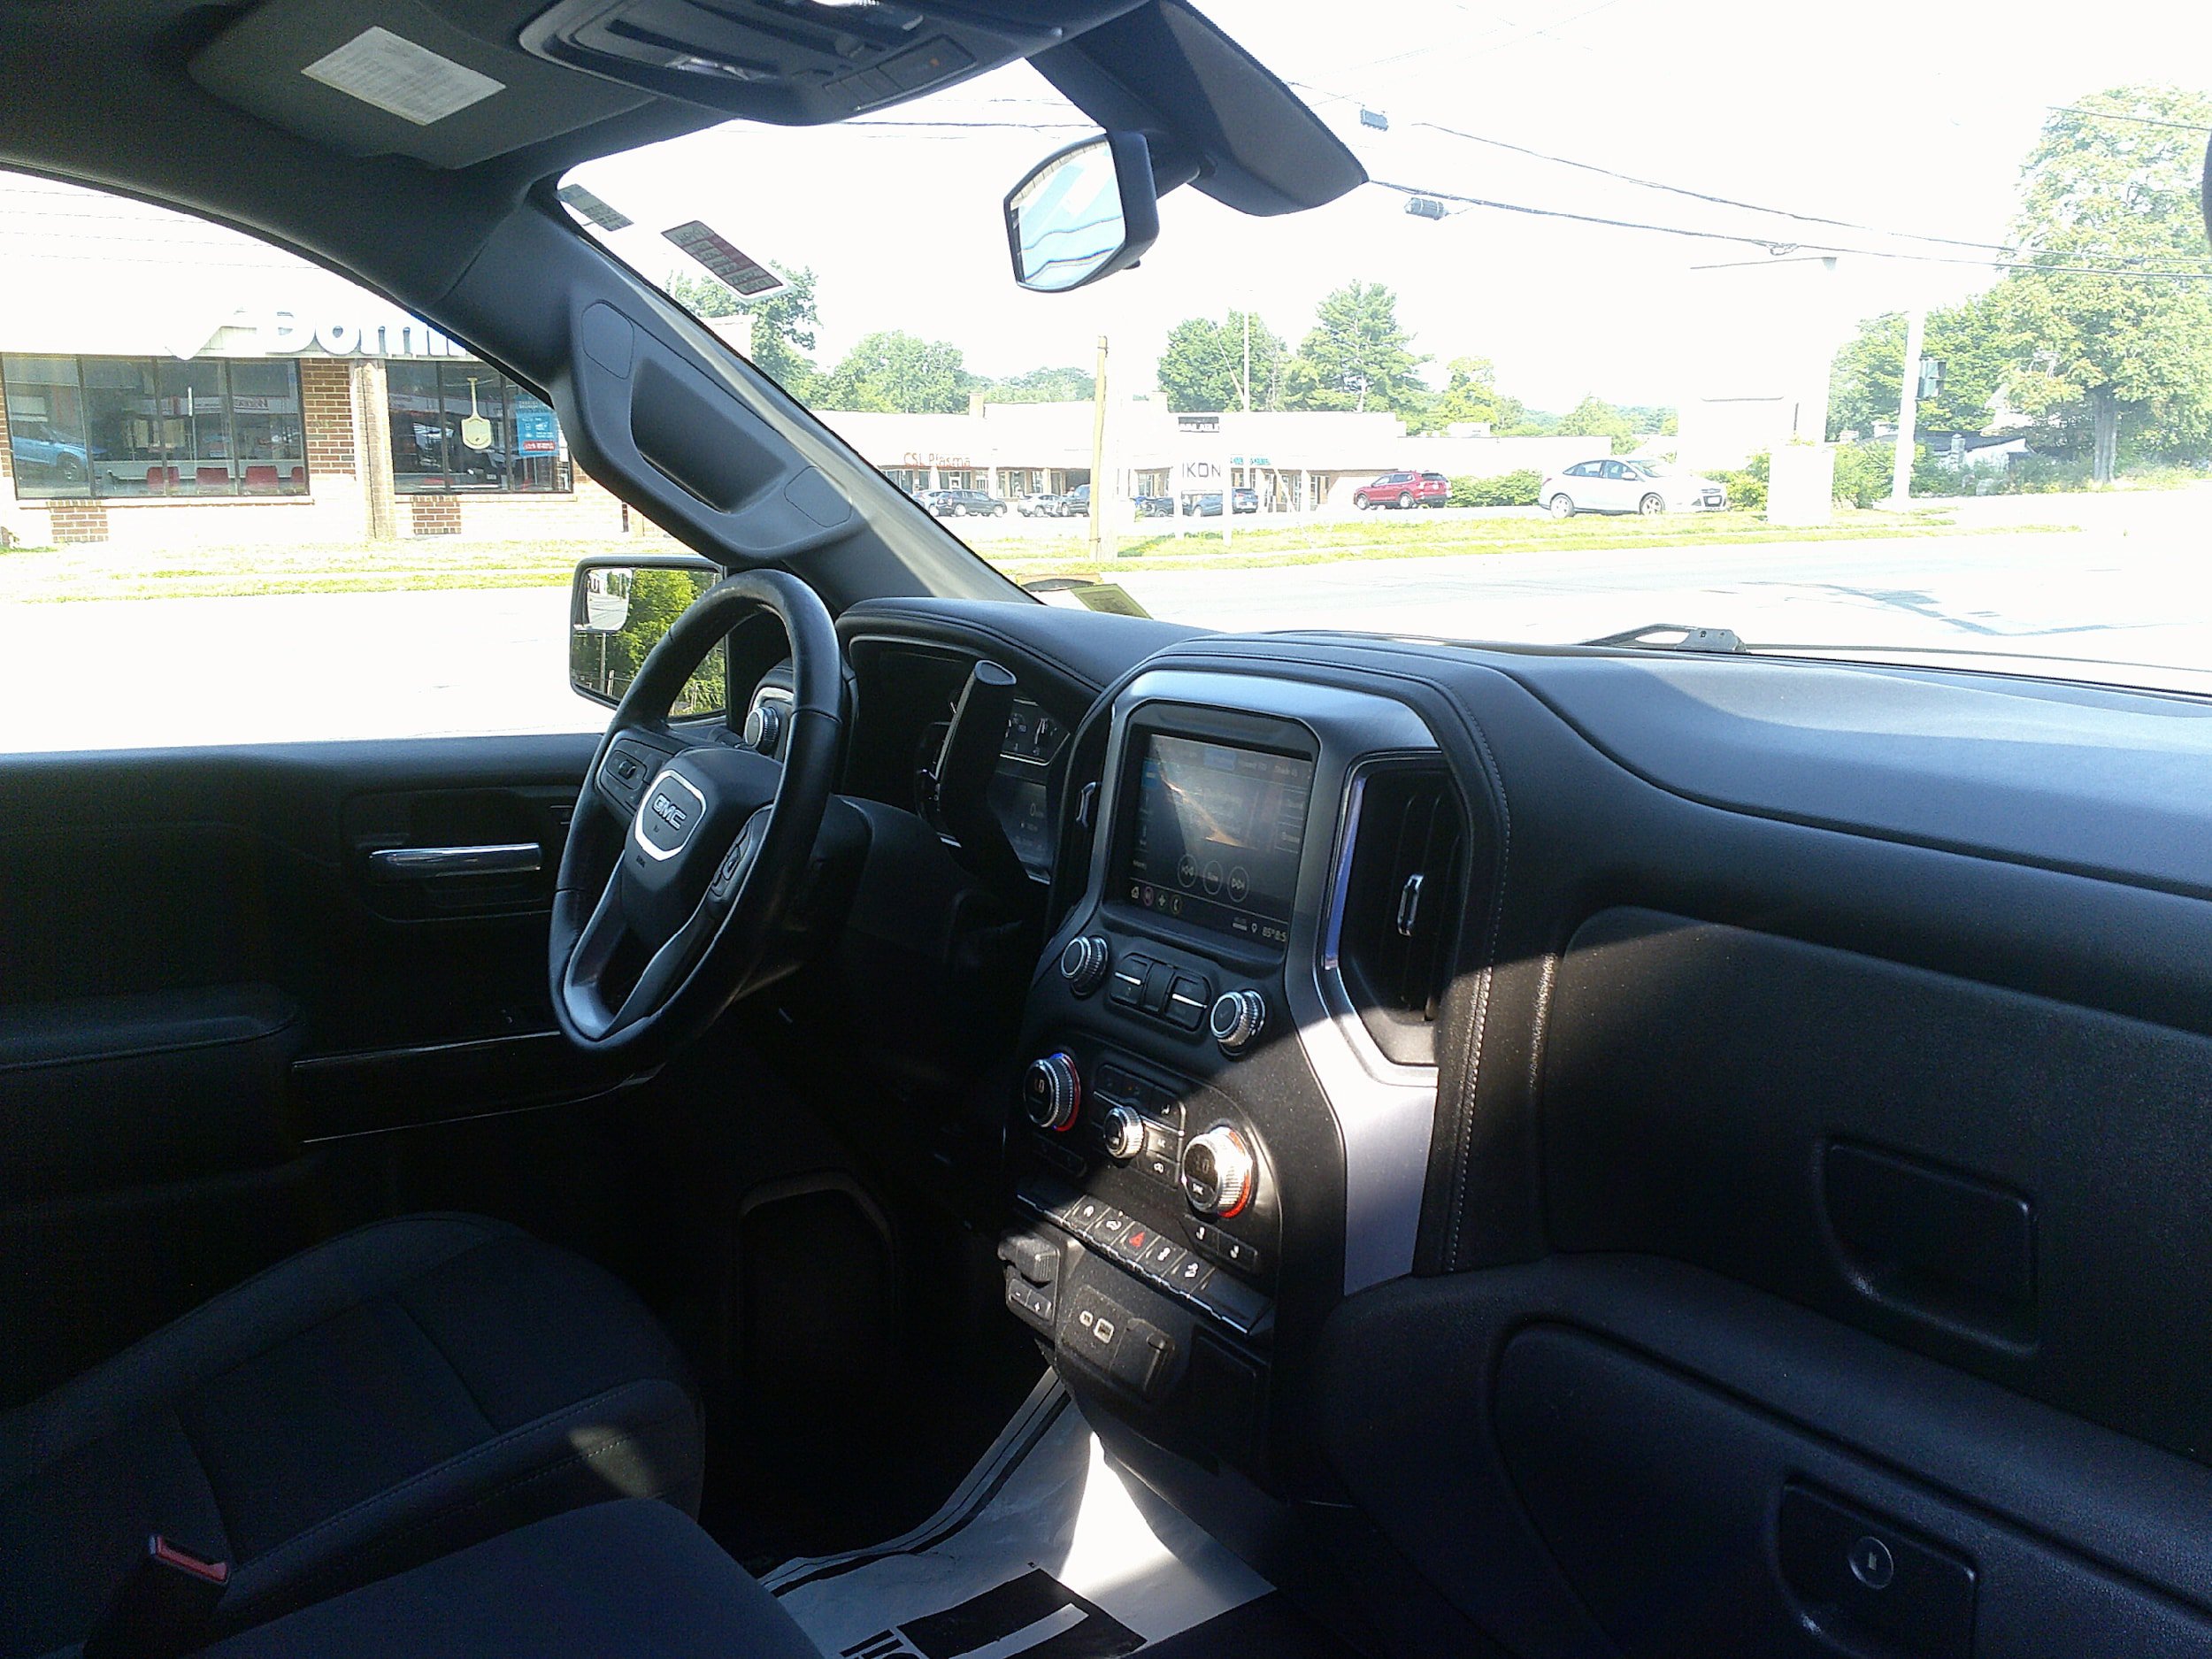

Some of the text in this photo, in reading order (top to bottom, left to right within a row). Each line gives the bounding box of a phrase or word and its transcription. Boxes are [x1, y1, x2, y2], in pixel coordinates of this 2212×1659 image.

[903, 452, 971, 468] CSL Plasma
[1182, 462, 1221, 478] IKON
[652, 793, 687, 831] GMC
